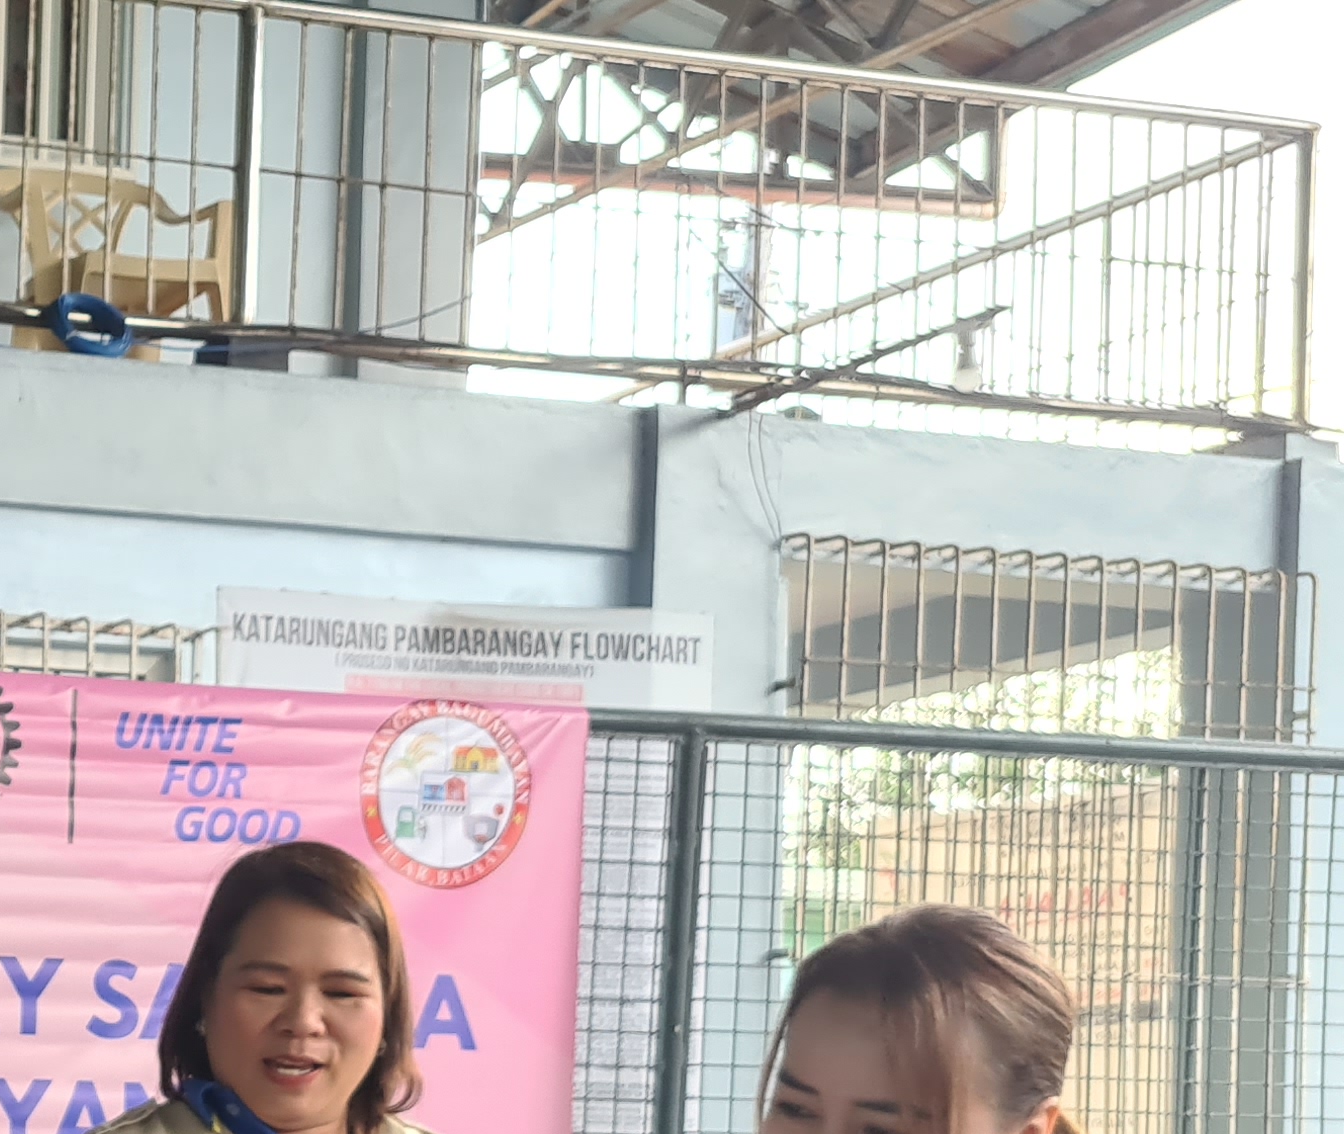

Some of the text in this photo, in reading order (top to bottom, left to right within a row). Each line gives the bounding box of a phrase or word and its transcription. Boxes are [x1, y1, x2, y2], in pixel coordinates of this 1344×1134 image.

[232, 612, 701, 664] KATARUNGANG PAMBARANGAY FLOWCHART
[115, 711, 243, 753] UNITE
[161, 759, 247, 799] FOR
[174, 806, 301, 844] GOOD
